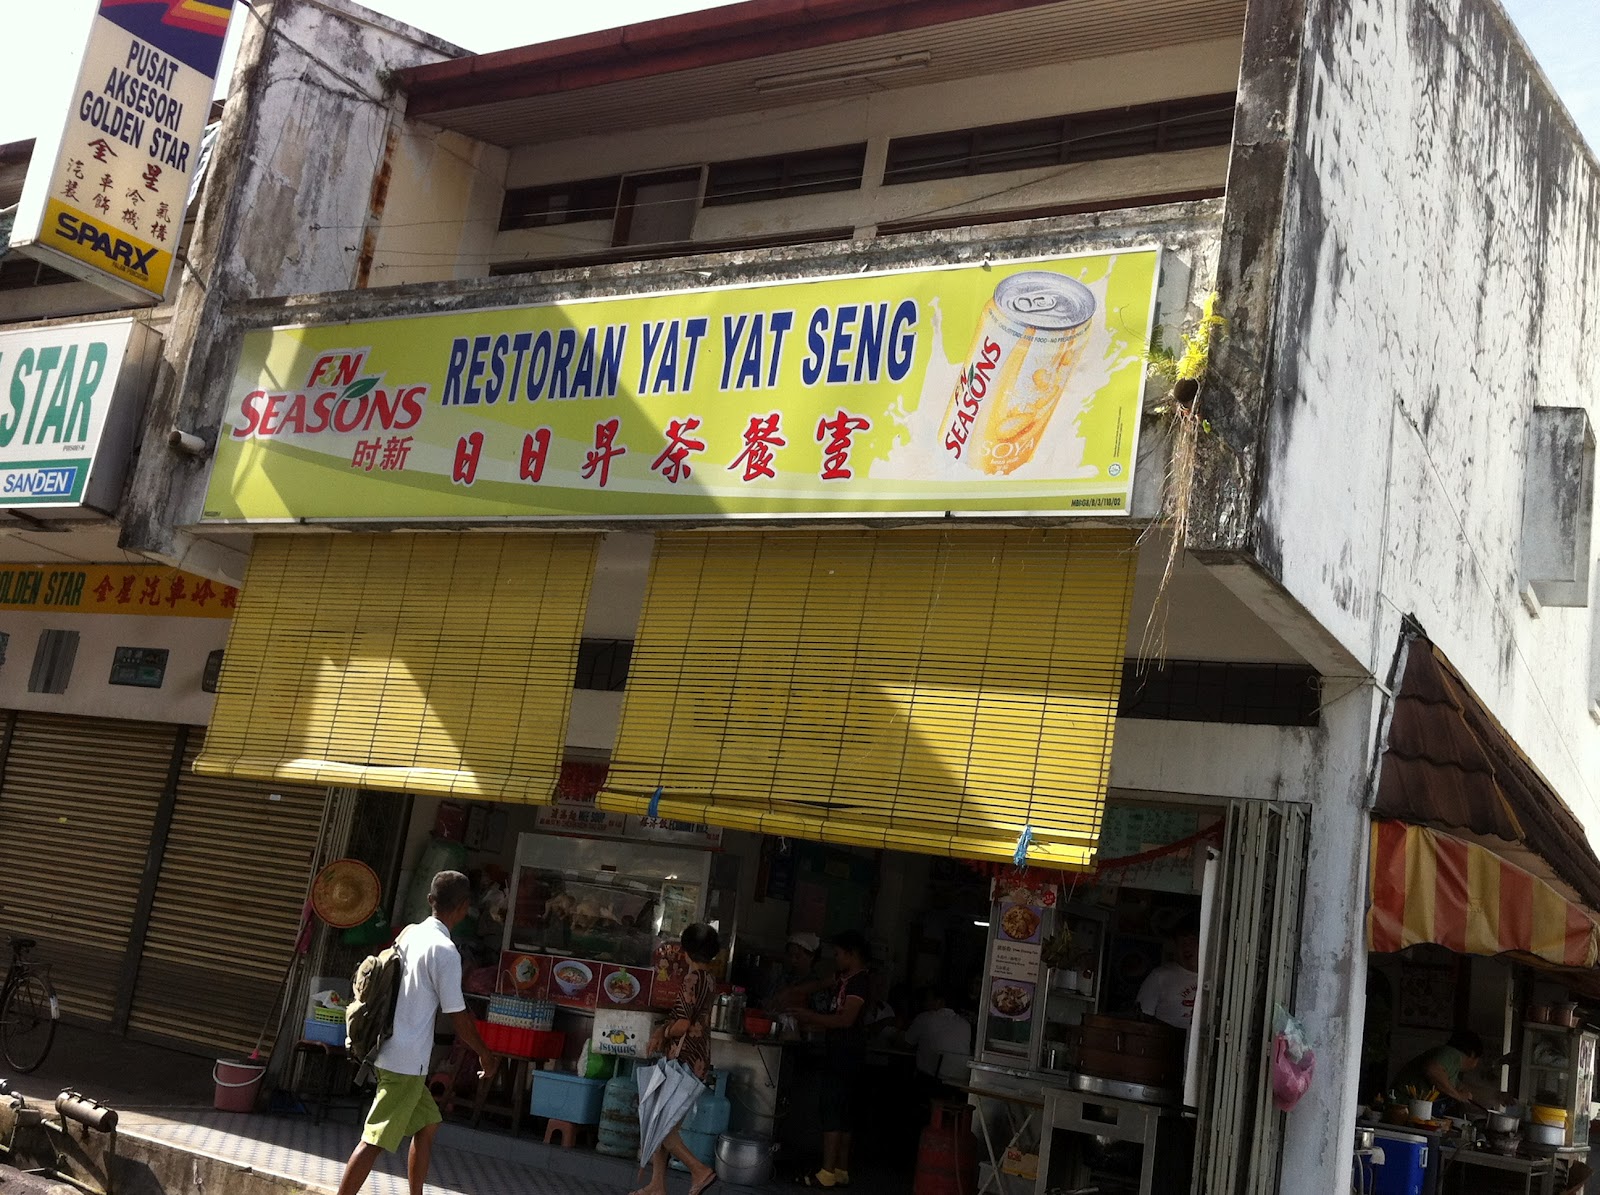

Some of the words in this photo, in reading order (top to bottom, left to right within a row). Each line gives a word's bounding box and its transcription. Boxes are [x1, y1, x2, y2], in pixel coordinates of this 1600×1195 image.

[126, 40, 179, 92] PUSAT
[103, 67, 184, 132] AKSESORI
[79, 90, 145, 148] GOLDEN
[149, 127, 190, 173] STAR
[88, 138, 163, 192] 金星
[55, 212, 159, 275] SPARX
[441, 325, 627, 406] RESTORAN
[638, 318, 708, 395] YAT
[720, 311, 793, 389] YAT
[802, 300, 917, 385] SENG
[0, 342, 108, 448] STAR
[233, 387, 427, 437] SEASONS
[945, 336, 1001, 459] SEASONS
[350, 435, 414, 472] 时新
[981, 437, 1035, 459] SOYA
[3, 470, 70, 495] SANDEN
[0, 571, 44, 604] OLDEN
[44, 571, 86, 606] STAR
[599, 1042, 637, 1055] Sunkist
